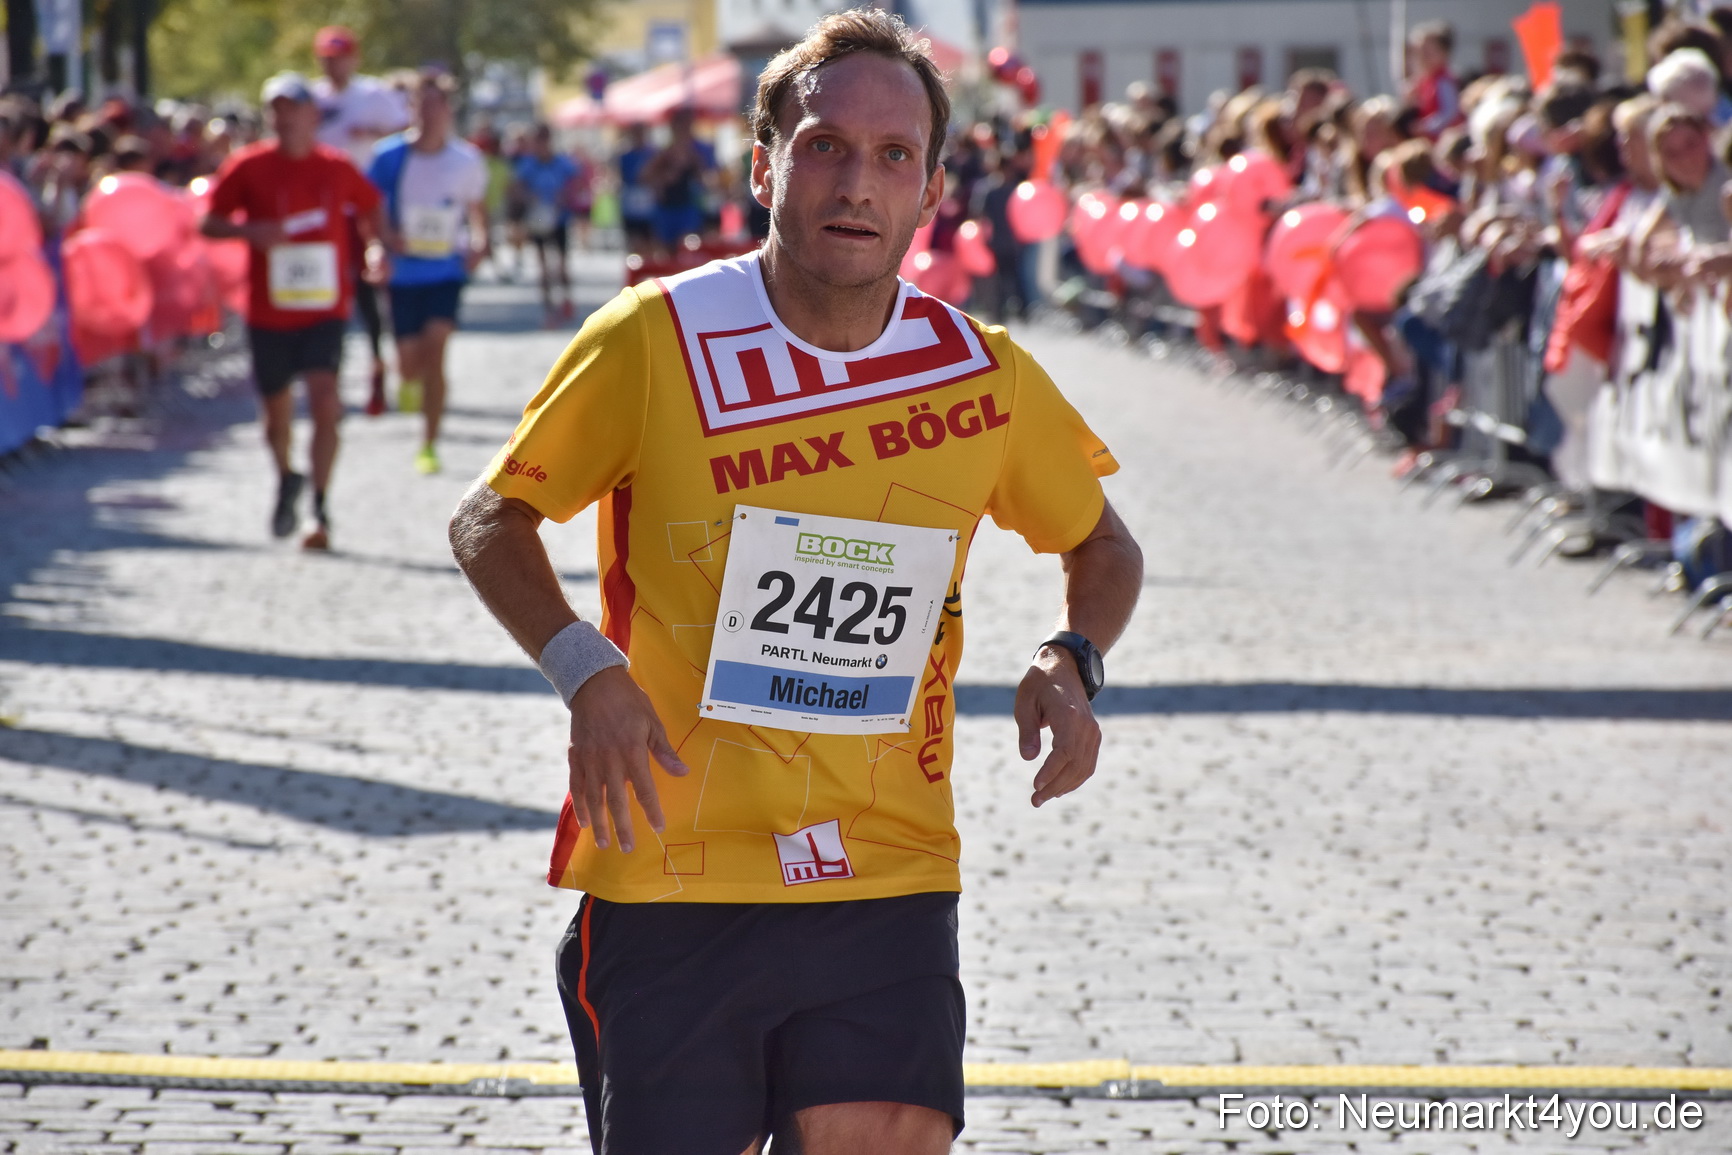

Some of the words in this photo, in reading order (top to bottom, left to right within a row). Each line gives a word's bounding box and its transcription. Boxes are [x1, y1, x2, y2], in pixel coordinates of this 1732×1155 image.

[709, 431, 856, 495] MAX
[867, 393, 1010, 460] BÖGL
[794, 554, 824, 565] inspired
[826, 559, 836, 567] by
[837, 561, 860, 570] smart
[861, 564, 894, 574] concepts
[796, 532, 896, 566] BOCK
[728, 616, 737, 627] D
[750, 570, 913, 645] 2425
[761, 644, 809, 662] PARTL
[812, 651, 872, 668] Neumarkt
[769, 675, 870, 710] Michael
